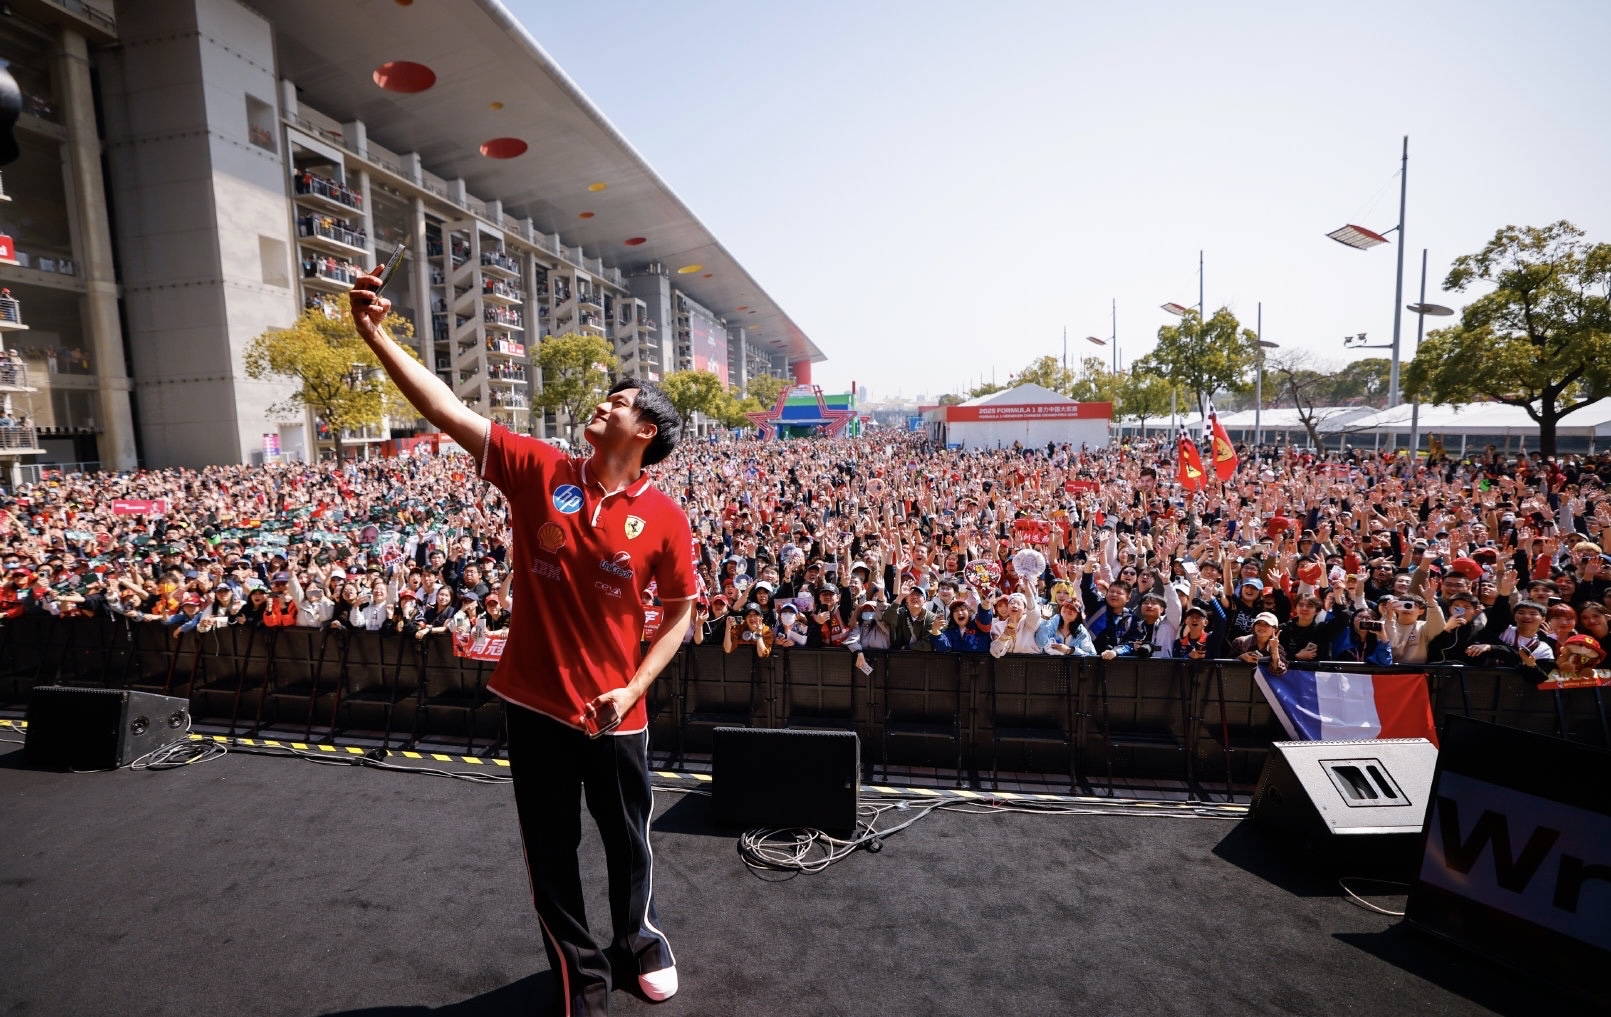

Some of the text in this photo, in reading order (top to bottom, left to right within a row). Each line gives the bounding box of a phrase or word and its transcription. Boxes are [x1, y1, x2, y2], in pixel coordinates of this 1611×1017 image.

[555, 486, 583, 512] hp
[532, 558, 561, 581] IBM
[600, 559, 634, 579] UniCredit
